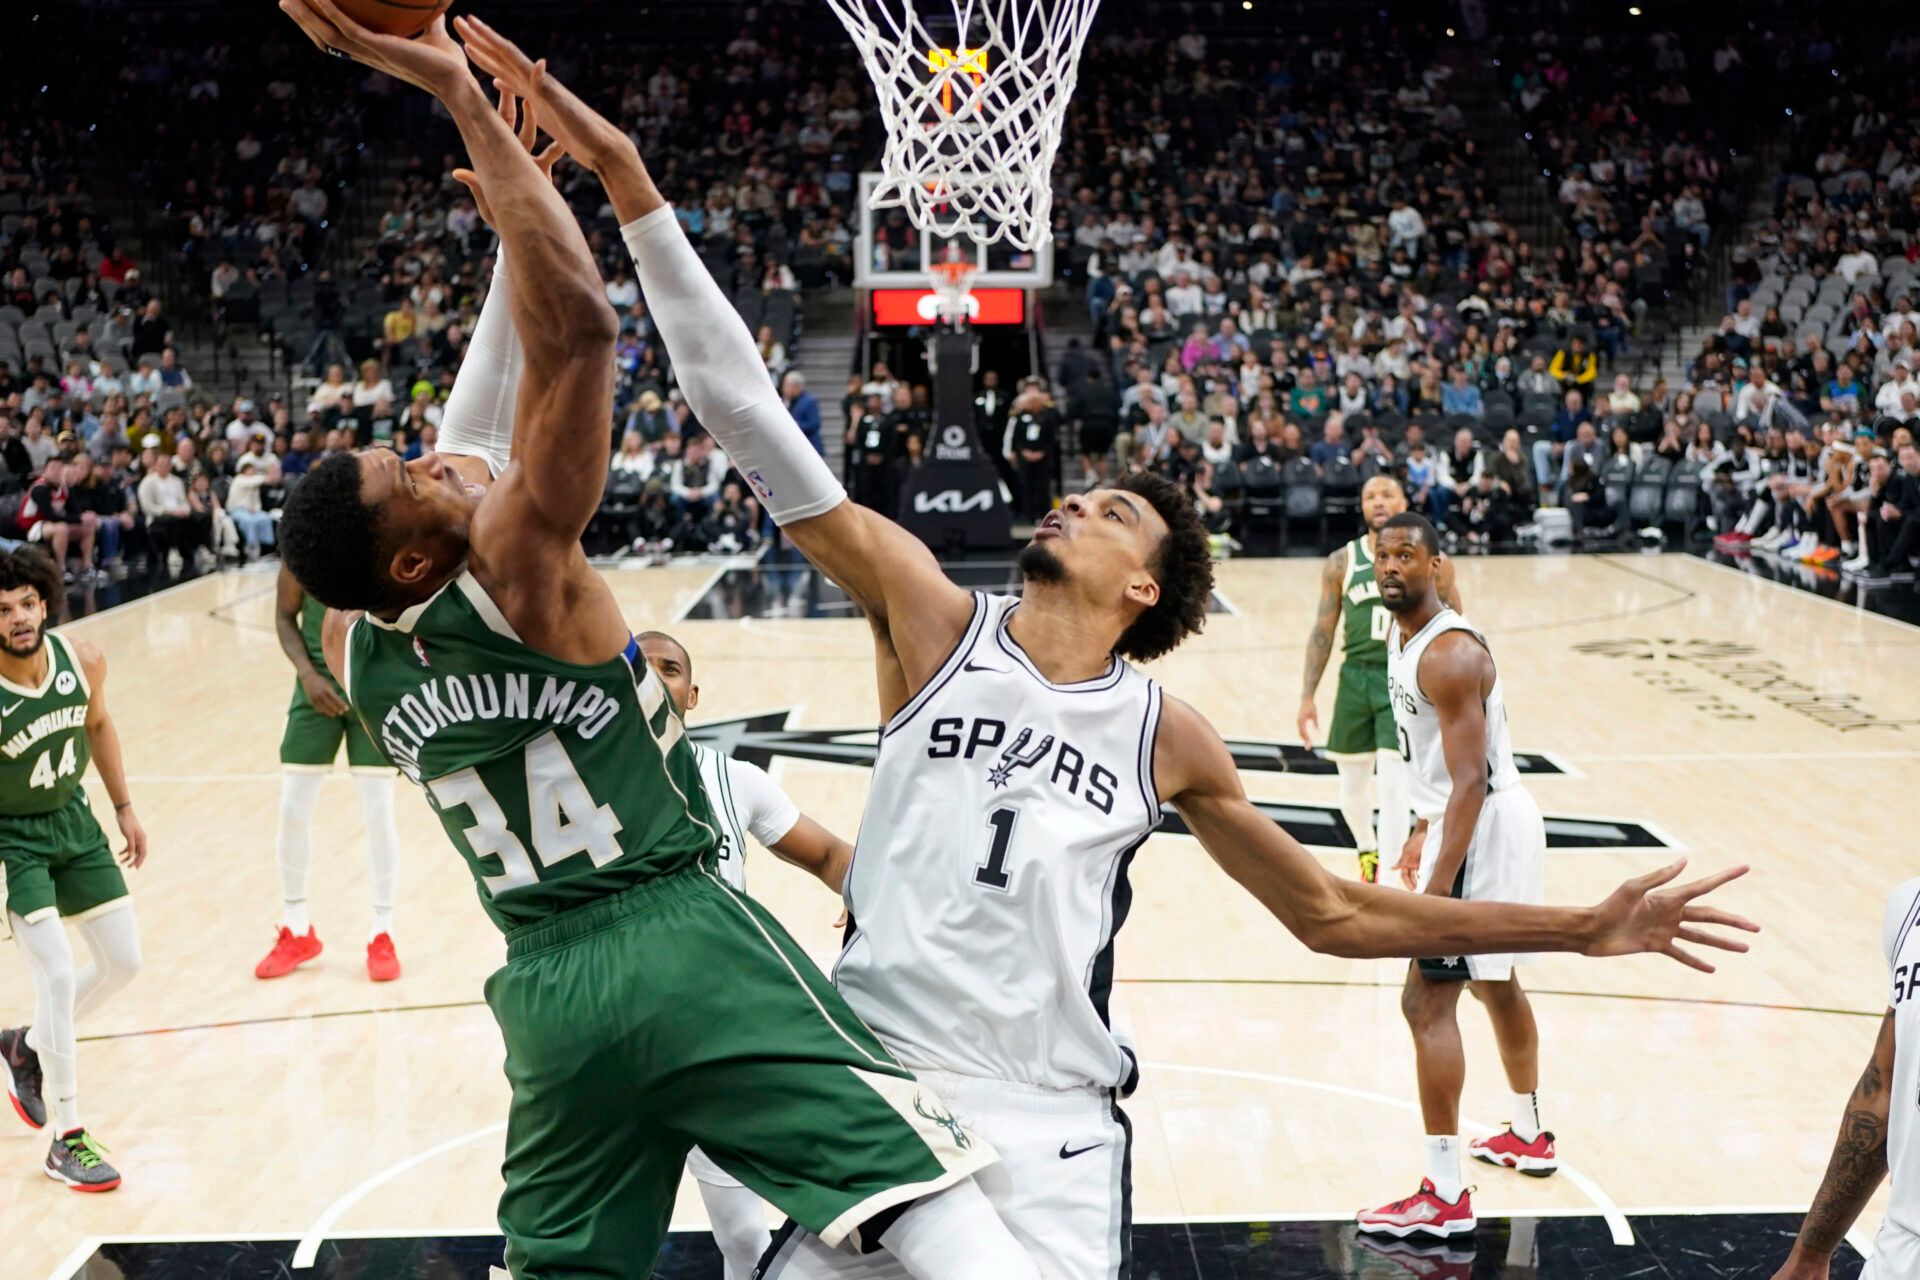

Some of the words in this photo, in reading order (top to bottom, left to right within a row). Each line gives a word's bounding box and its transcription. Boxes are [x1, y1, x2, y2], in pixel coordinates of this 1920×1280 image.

[29, 736, 77, 790] 44
[927, 717, 1119, 815] SPURS
[426, 730, 624, 897] 34
[972, 804, 1020, 893] 1
